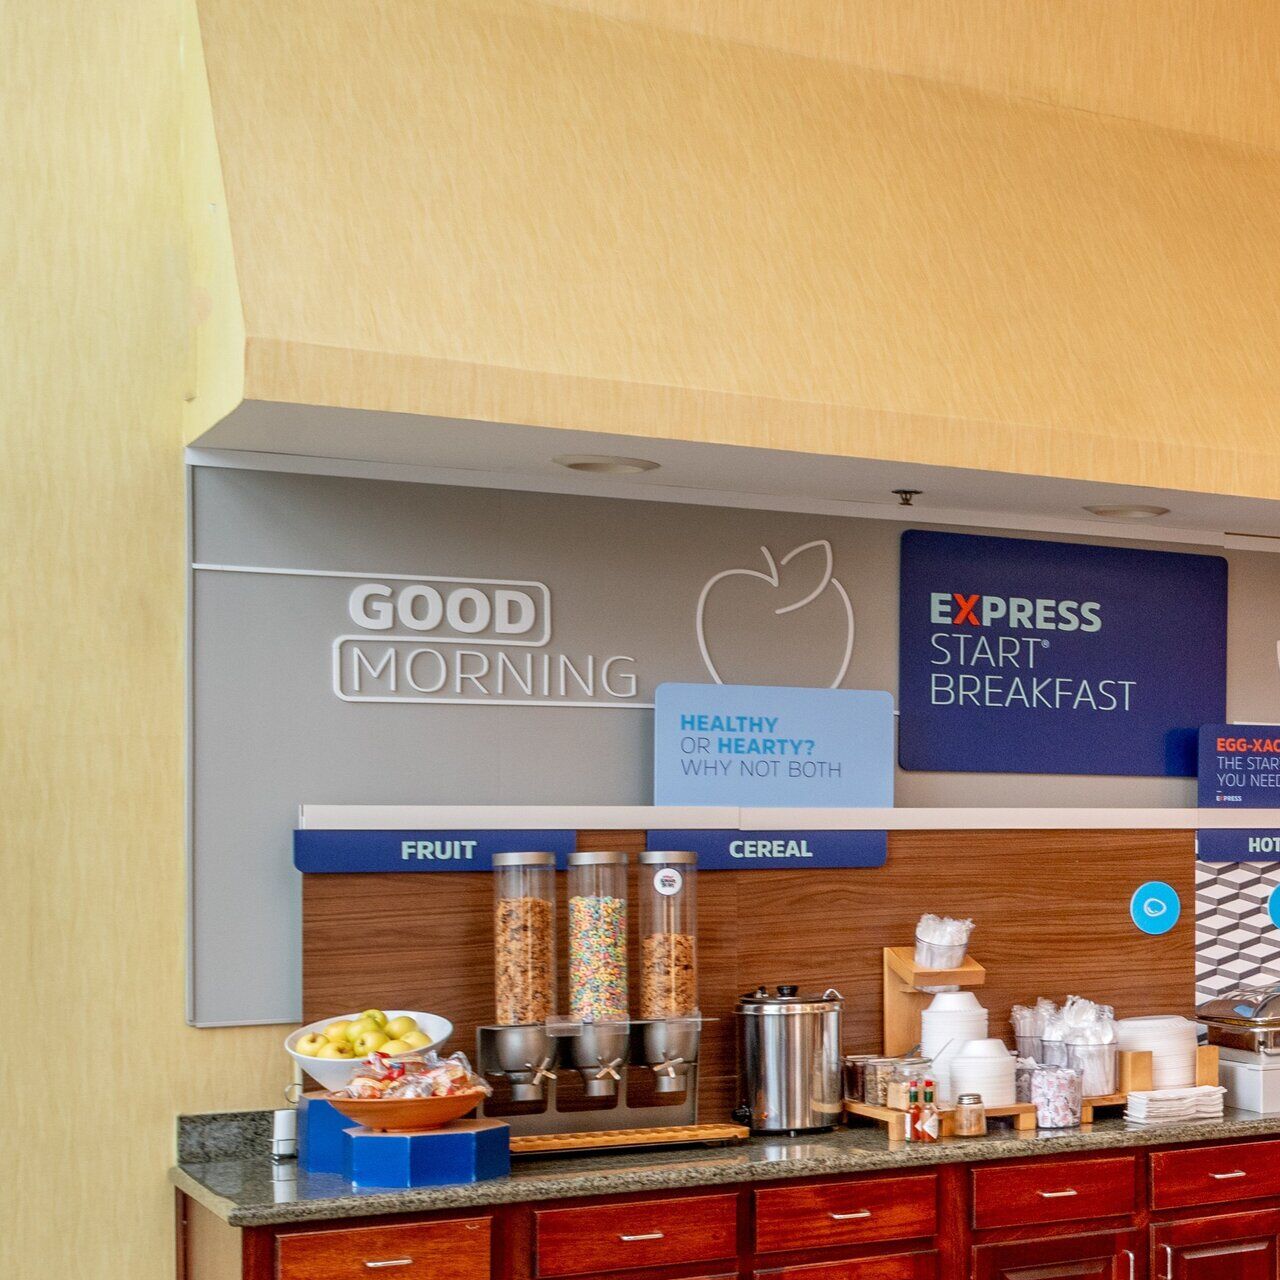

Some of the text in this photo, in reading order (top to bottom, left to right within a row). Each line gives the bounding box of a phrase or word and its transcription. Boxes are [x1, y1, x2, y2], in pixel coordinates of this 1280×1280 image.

[349, 584, 535, 634] GOOD
[931, 592, 1102, 632] EXPRESS
[353, 646, 637, 698] MORNING
[931, 673, 1137, 711] BREAKFAST
[681, 714, 779, 733] HEALTHY
[680, 736, 816, 755] OR HEARTY?
[681, 759, 841, 778] WHY NOT BOTH
[1217, 756, 1242, 770] THE
[1217, 773, 1246, 787] YOU
[401, 841, 478, 860] FRUIT
[729, 840, 813, 858] CEREAL
